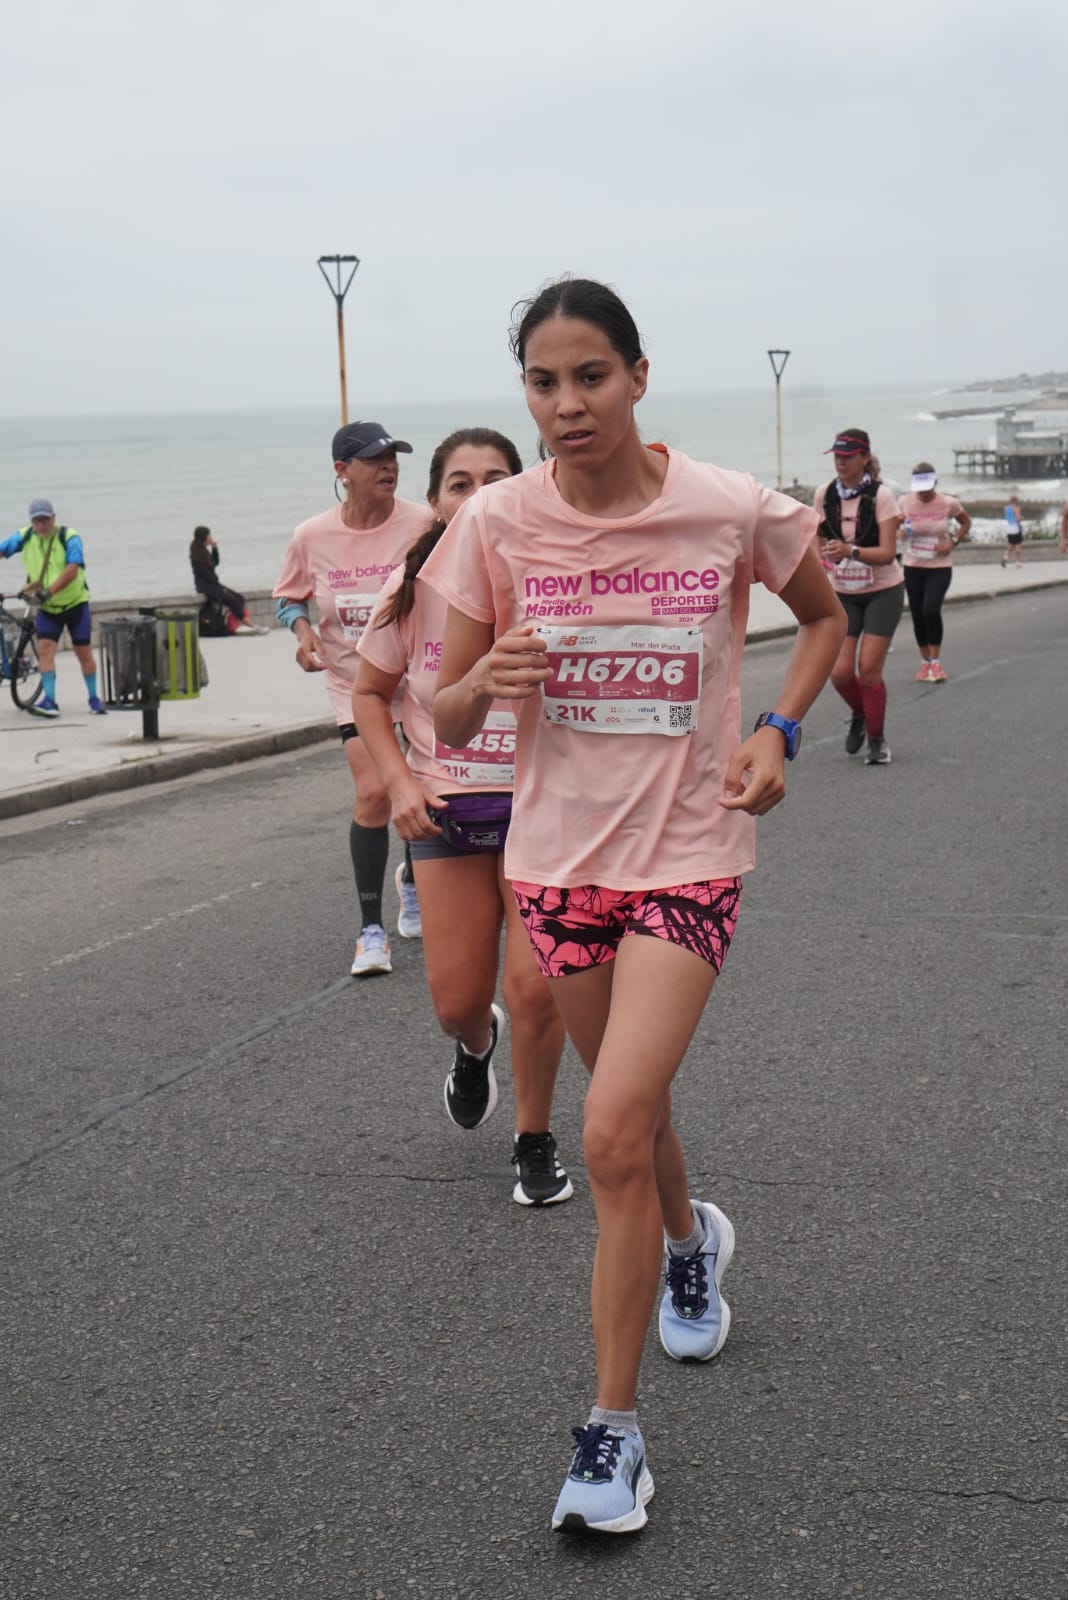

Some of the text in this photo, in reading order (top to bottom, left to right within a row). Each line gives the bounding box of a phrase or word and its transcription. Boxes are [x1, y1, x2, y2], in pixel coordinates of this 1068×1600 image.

[328, 570, 352, 580] new
[525, 567, 720, 598] new balance
[650, 594, 719, 607] DEPORTES
[526, 601, 594, 617] Maratón
[424, 641, 443, 657] ne
[631, 641, 646, 649] Mar
[661, 642, 681, 651] Plata
[556, 656, 687, 685] H6706
[557, 704, 597, 723] 21K
[464, 733, 517, 753] 455
